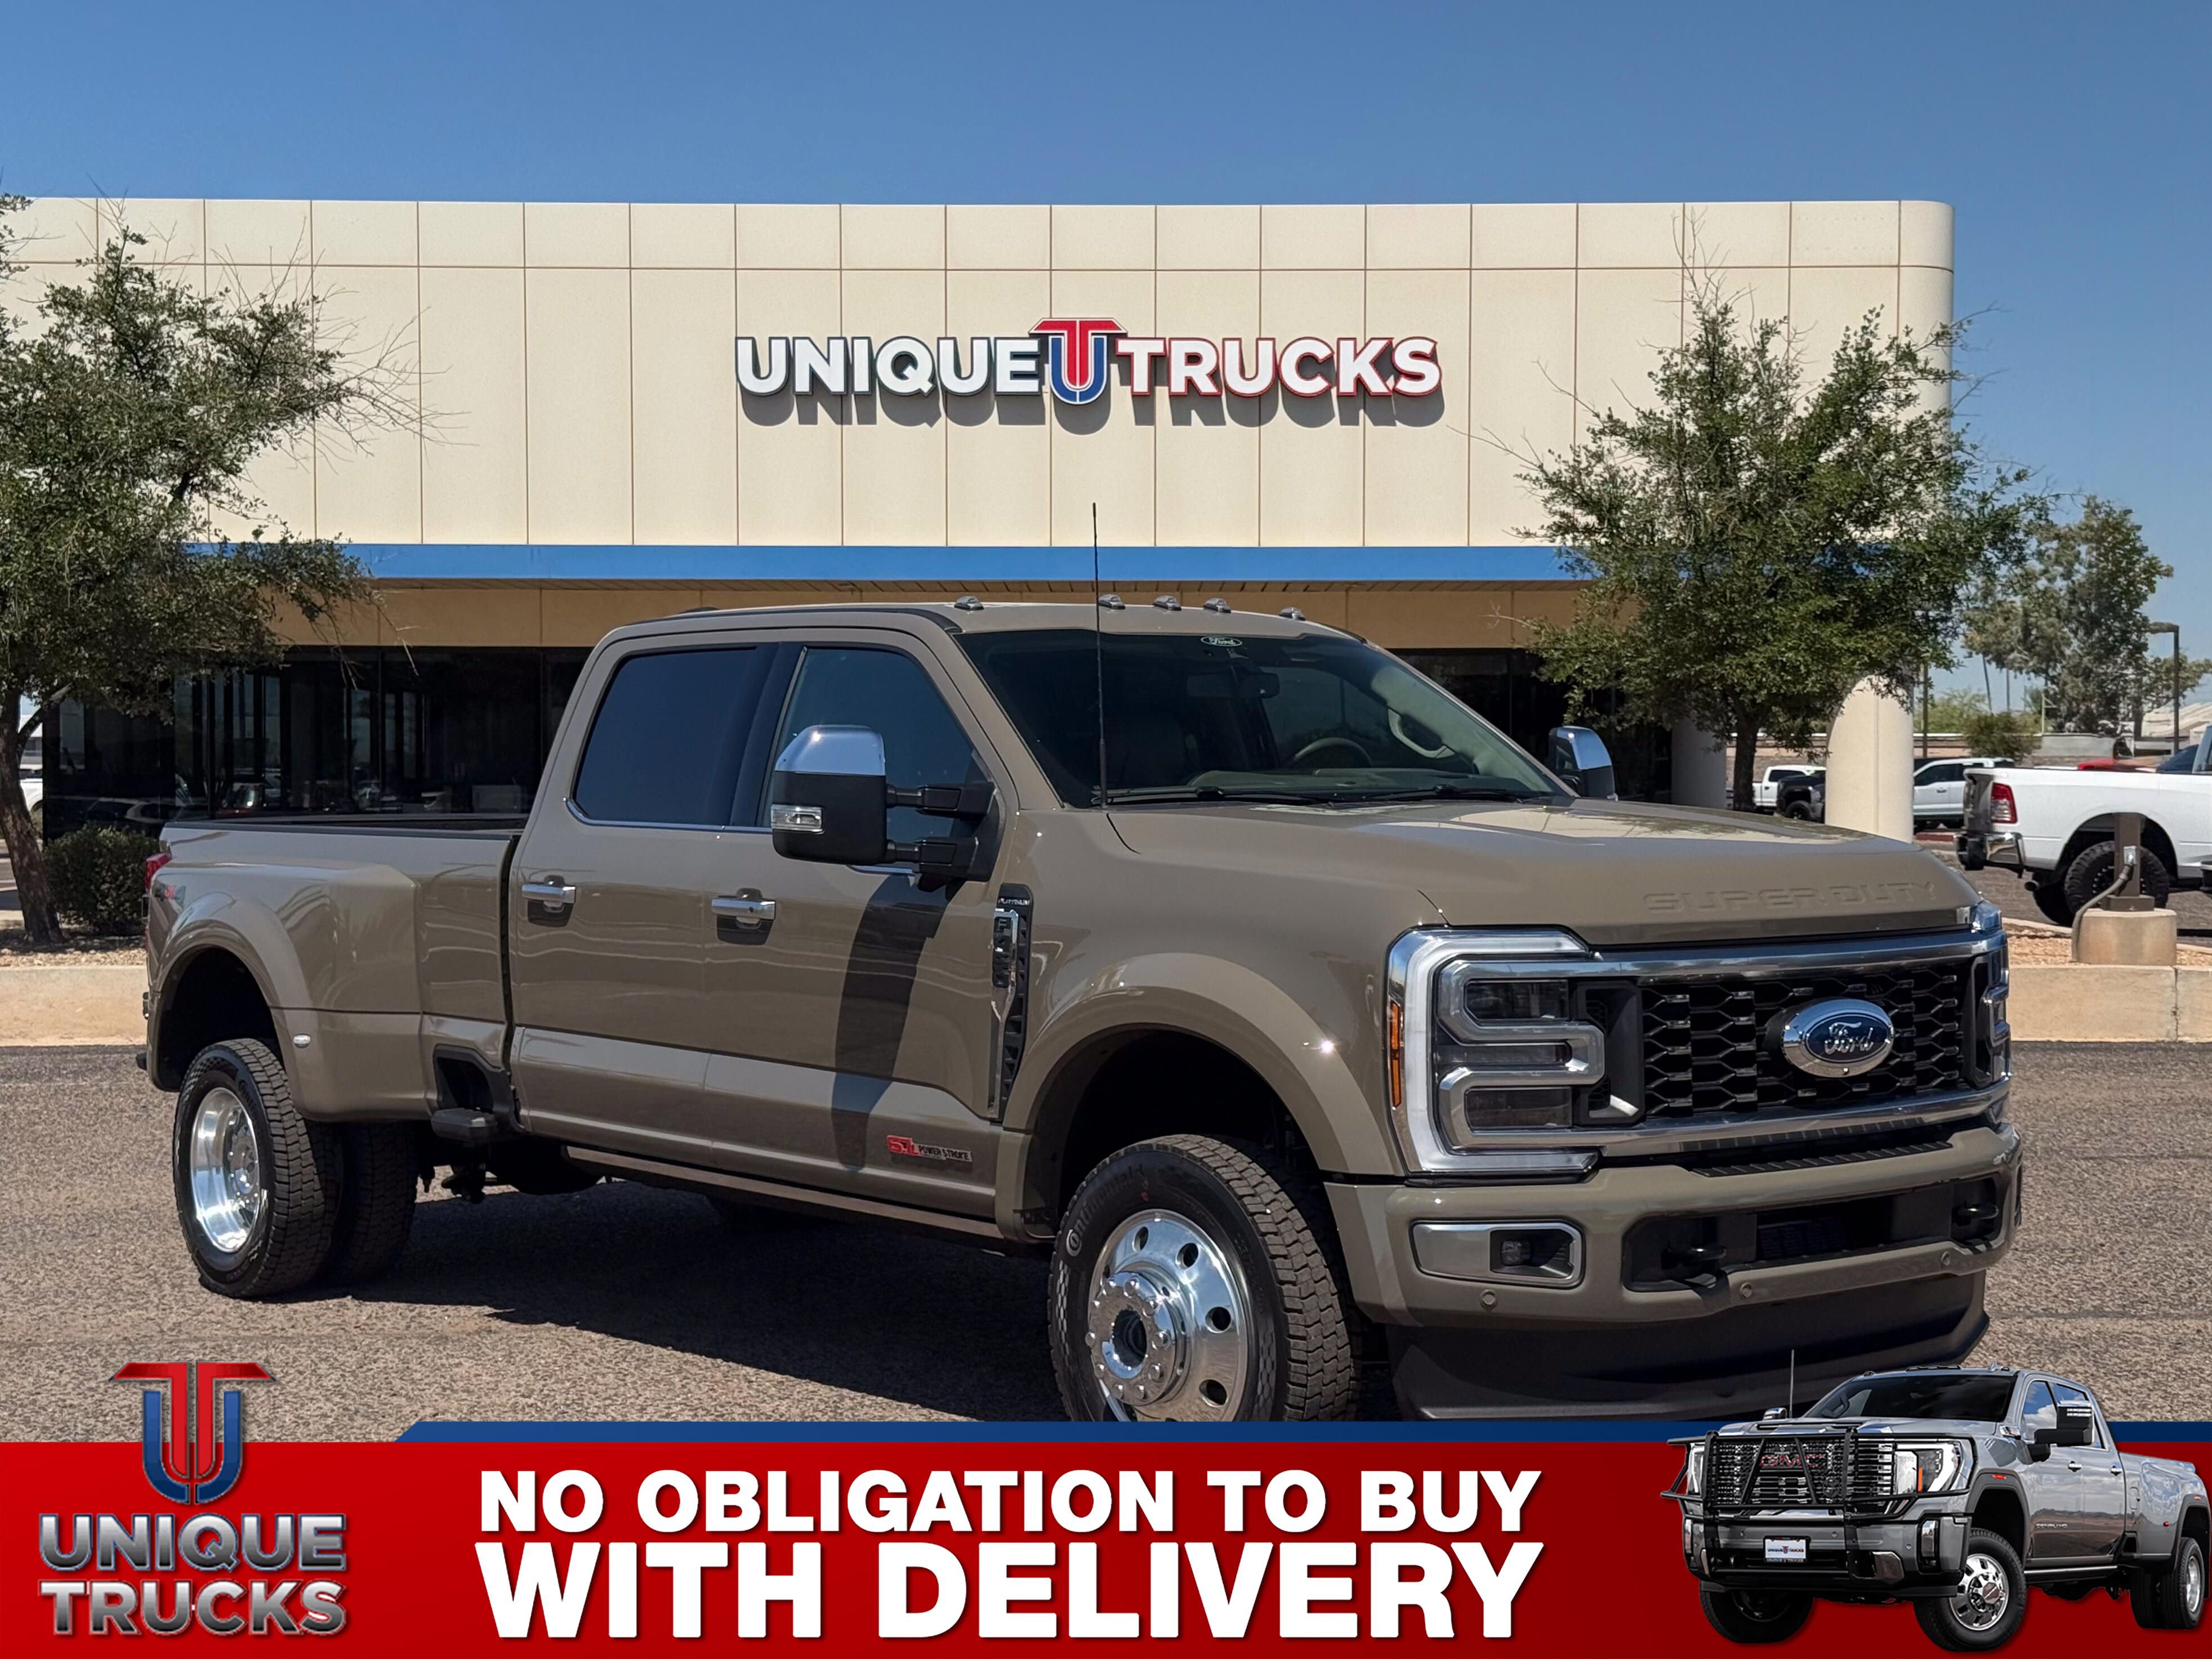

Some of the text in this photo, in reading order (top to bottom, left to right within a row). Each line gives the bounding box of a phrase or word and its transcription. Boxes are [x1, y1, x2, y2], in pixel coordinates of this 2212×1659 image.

[735, 337, 1039, 396] UNIQUE
[1116, 337, 1442, 398] TRUCKS
[1643, 881, 1936, 913] SUPER DUTY
[1825, 1022, 1874, 1055] Ford
[918, 1145, 943, 1157] POWER
[942, 1148, 970, 1161] STROKE
